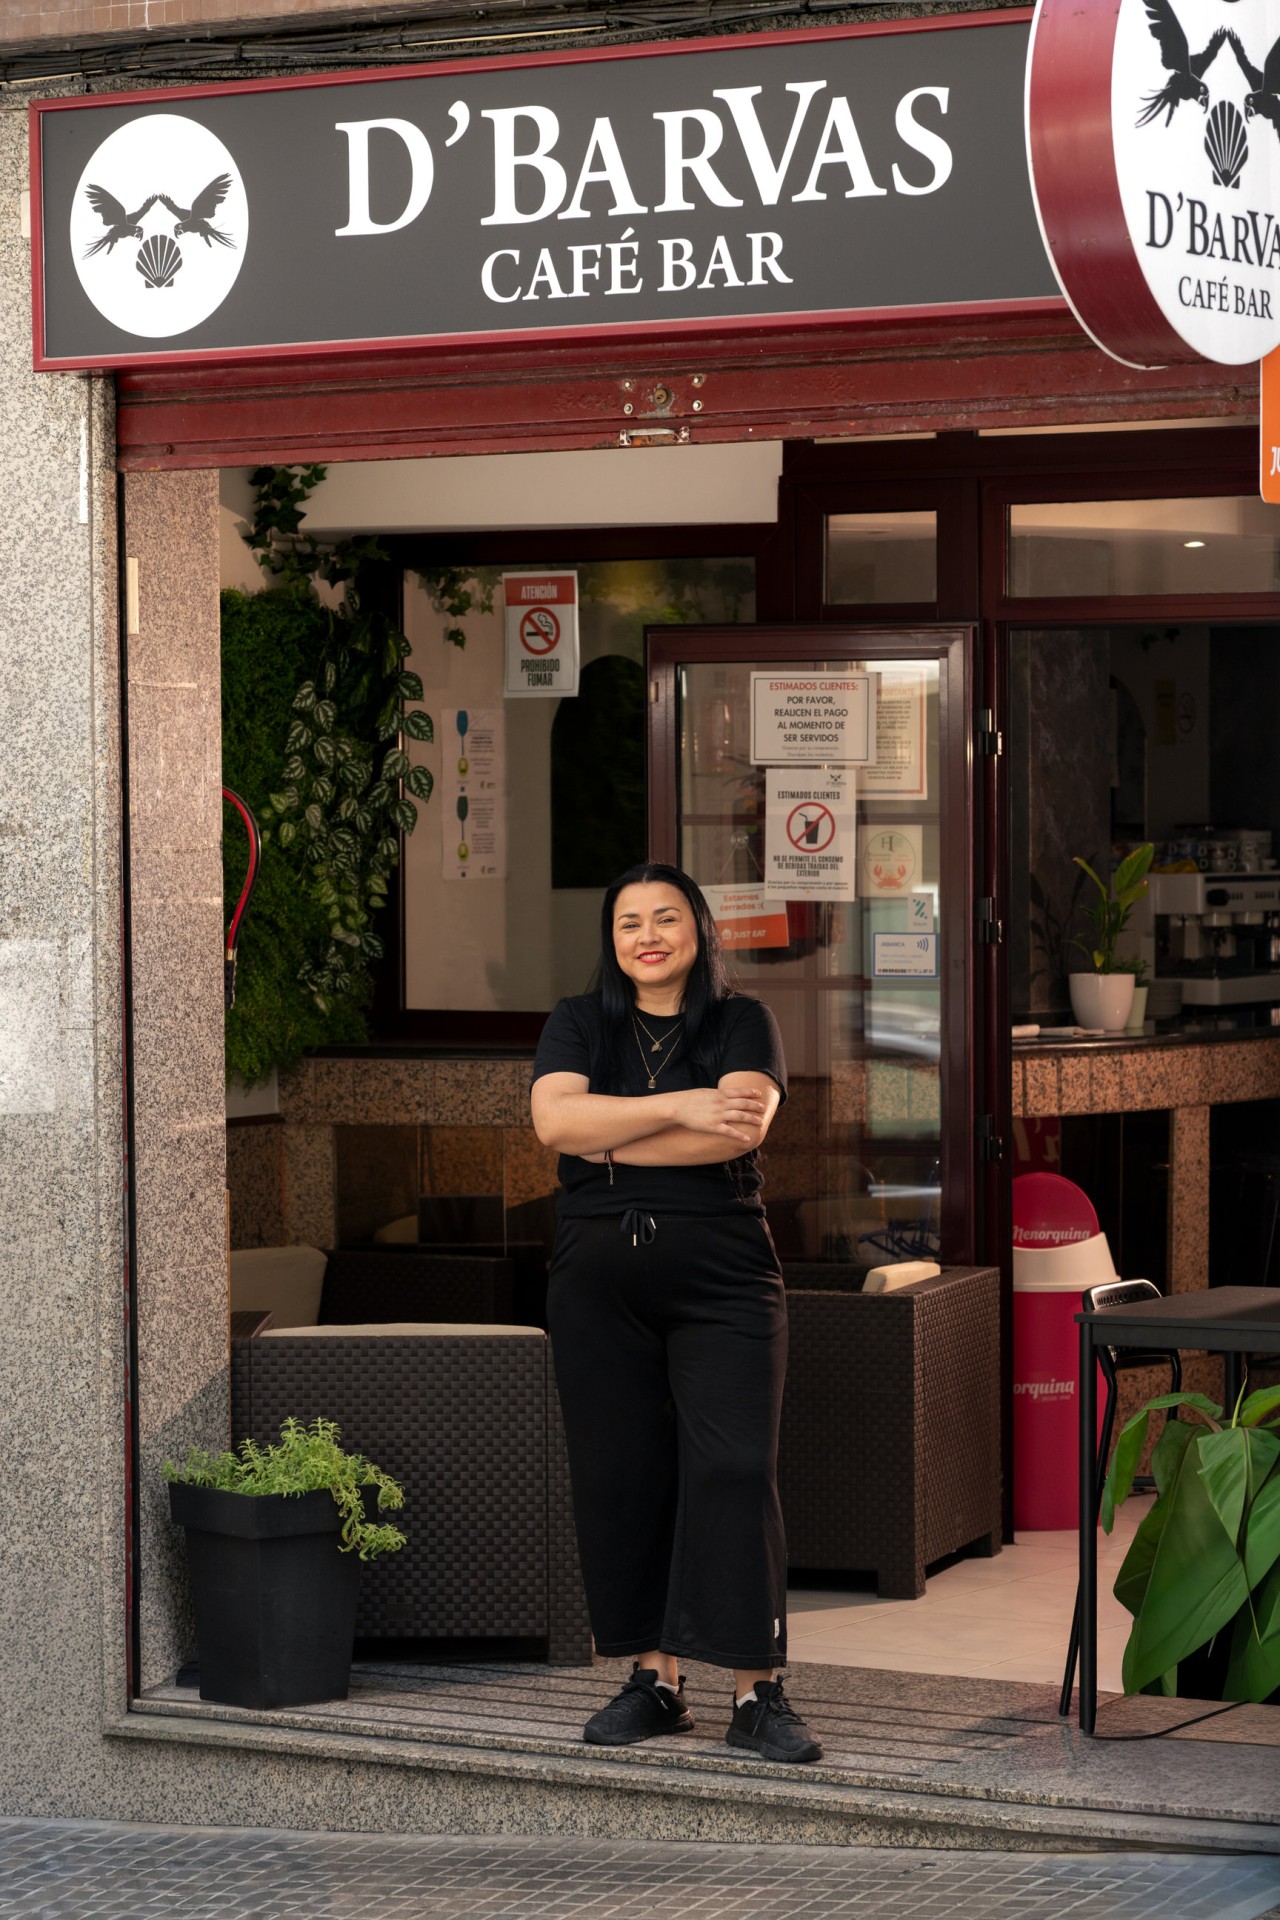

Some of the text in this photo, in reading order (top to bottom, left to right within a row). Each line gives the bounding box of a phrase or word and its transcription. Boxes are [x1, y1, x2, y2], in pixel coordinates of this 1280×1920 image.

[335, 80, 953, 237] D'BARVAS
[481, 228, 793, 304] CAFÉ BAR
[1178, 275, 1274, 320] CAFÉ BAR
[521, 582, 558, 600] ATENCIÓN
[521, 659, 560, 672] PROHIBIDO
[528, 673, 553, 686] FUMAR
[769, 682, 858, 690] ESTIMADOS CLIENTES:
[787, 696, 836, 705] POR FAVOR,
[774, 709, 848, 717] REALICEN EL PAGO
[777, 721, 845, 729] AL MOMENTO DE
[784, 734, 839, 742] SER SERVIDOS
[778, 791, 840, 800] ESTIMADOS CLIENTES
[723, 894, 759, 902] Estamos
[720, 903, 755, 911] cerrados
[734, 930, 766, 939] JUST EAT
